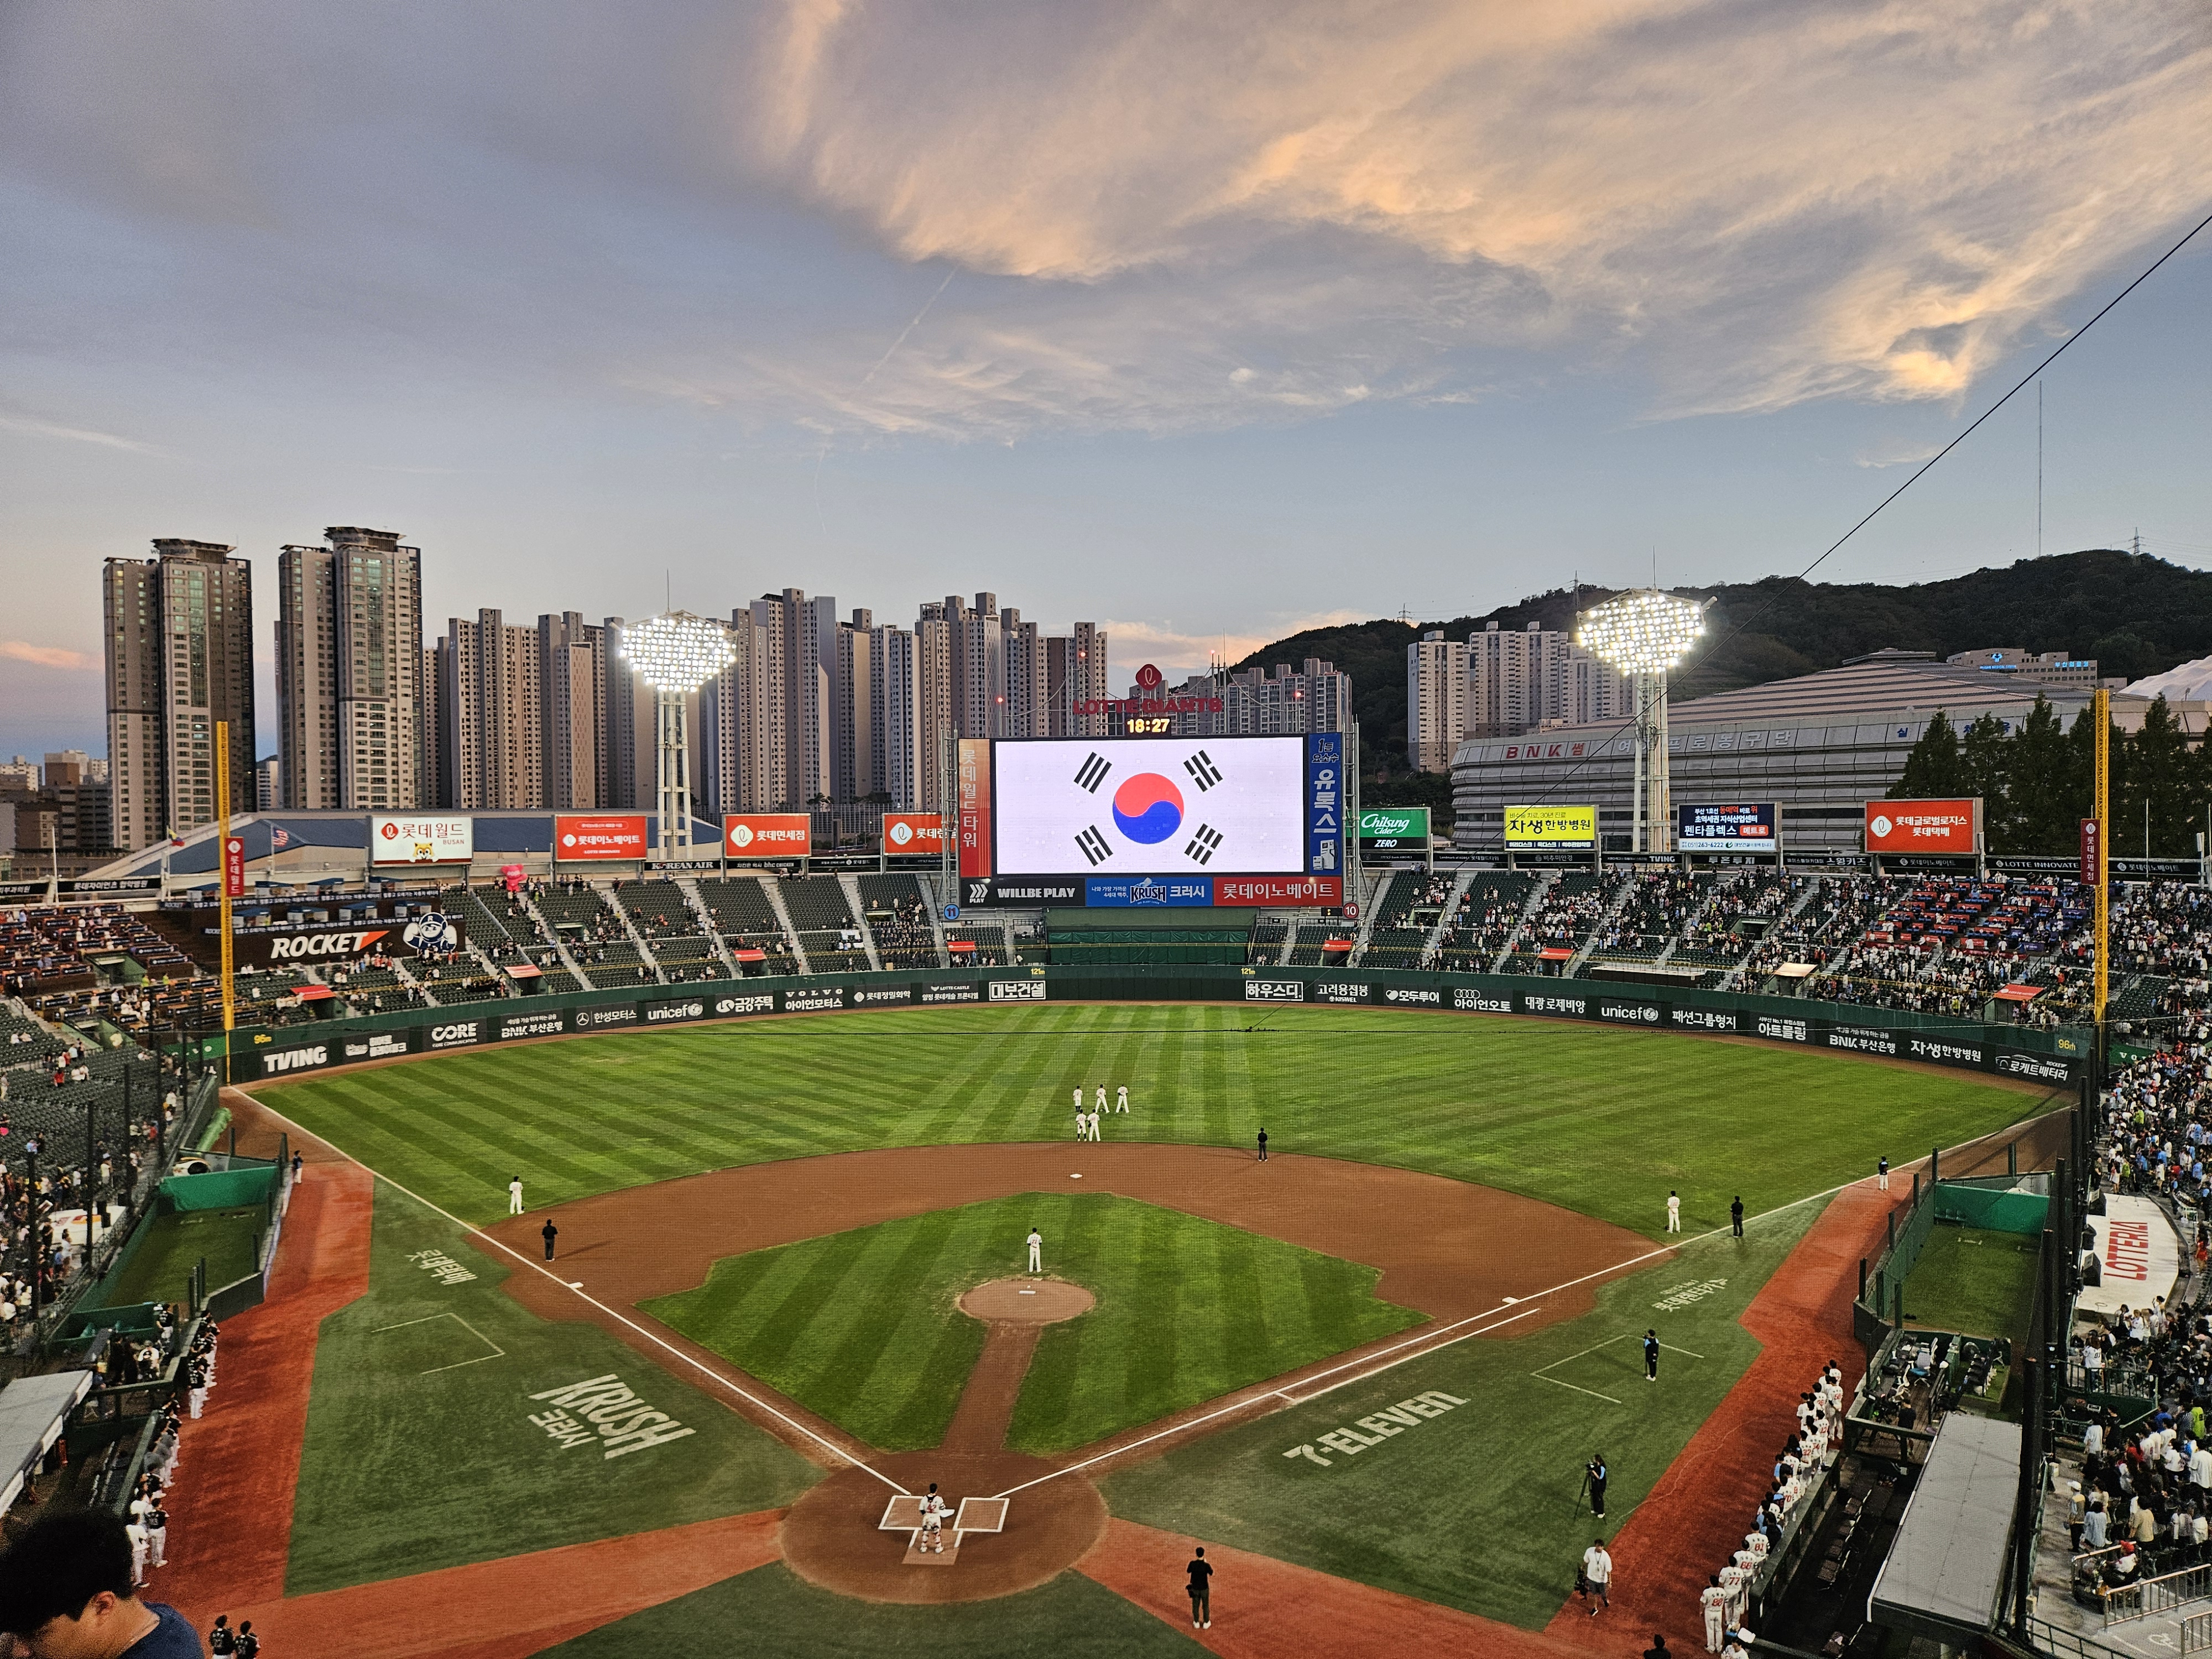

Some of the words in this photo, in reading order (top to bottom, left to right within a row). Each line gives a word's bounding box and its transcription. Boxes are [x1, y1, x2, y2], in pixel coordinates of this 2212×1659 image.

[1073, 700, 1139, 714] LOTTE
[1142, 697, 1223, 713] GIANTS
[1127, 718, 1170, 733] 18:27
[1318, 738, 1334, 753] 1등
[1618, 730, 1791, 753] 여프로농구단
[1506, 743, 1562, 758] BNK
[962, 749, 978, 847] 롯데월드타워
[1313, 769, 1337, 833] 유록스
[1751, 805, 1757, 813] 위
[1361, 813, 1410, 833] Chilsung
[1509, 819, 1591, 834] 자생한방병원
[1896, 816, 1968, 827] 롯데글로벌로지스
[402, 822, 464, 839] 롯데월드
[757, 830, 805, 841] 롯데면세점
[1684, 825, 1738, 837] 펜타플렉스
[1743, 827, 1766, 835] 메트로
[1912, 827, 1950, 837] 롯데택배
[578, 835, 641, 845] 롯데이노베이트
[1374, 839, 1397, 847] ZERO
[2086, 836, 2095, 881] 롯데면세점
[997, 888, 1042, 898] WILLBE
[1044, 888, 1076, 898] PLAY
[1130, 885, 1167, 904] KRUSH
[1170, 885, 1205, 898] 크러시
[1223, 883, 1334, 899] 롯데이노베이트
[946, 907, 956, 917] 11
[1345, 906, 1357, 916] 10
[271, 931, 372, 959] ROCKET
[785, 988, 843, 998] VOLVO
[866, 990, 911, 1001] 롯데정밀화학
[991, 983, 1045, 999] 대보건설
[1317, 984, 1369, 997] 고려용접봉
[1399, 990, 1439, 1003] 모두투어
[648, 1004, 688, 1020] unicef
[735, 995, 774, 1013] 금강주택
[785, 998, 843, 1011] 아이언모터스
[1454, 998, 1511, 1013] 아이언오토
[1525, 996, 1545, 1011] 대광
[1546, 998, 1586, 1014] 로제비앙
[1601, 1004, 1644, 1020] unicef
[593, 1009, 637, 1022] 한성모터스
[1672, 1010, 1736, 1029] 패션그룹형지
[502, 1026, 528, 1038] BNK
[529, 1021, 563, 1033] 부산은행
[1759, 1023, 1806, 1041] 아트몰링
[1829, 1035, 1858, 1048] BNK
[1859, 1039, 1896, 1054] 부산은행
[1911, 1040, 1981, 1062] 자생한방병원
[2058, 1039, 2076, 1051] 96m
[263, 1046, 327, 1072] TVING
[2008, 1061, 2068, 1081] 로케트배터리
[2104, 1218, 2149, 1281] LOTTERIA
[528, 1373, 697, 1460] KRUSH
[527, 1408, 598, 1449] 크러시
[1282, 1390, 1471, 1467] 7-ELEVEN
